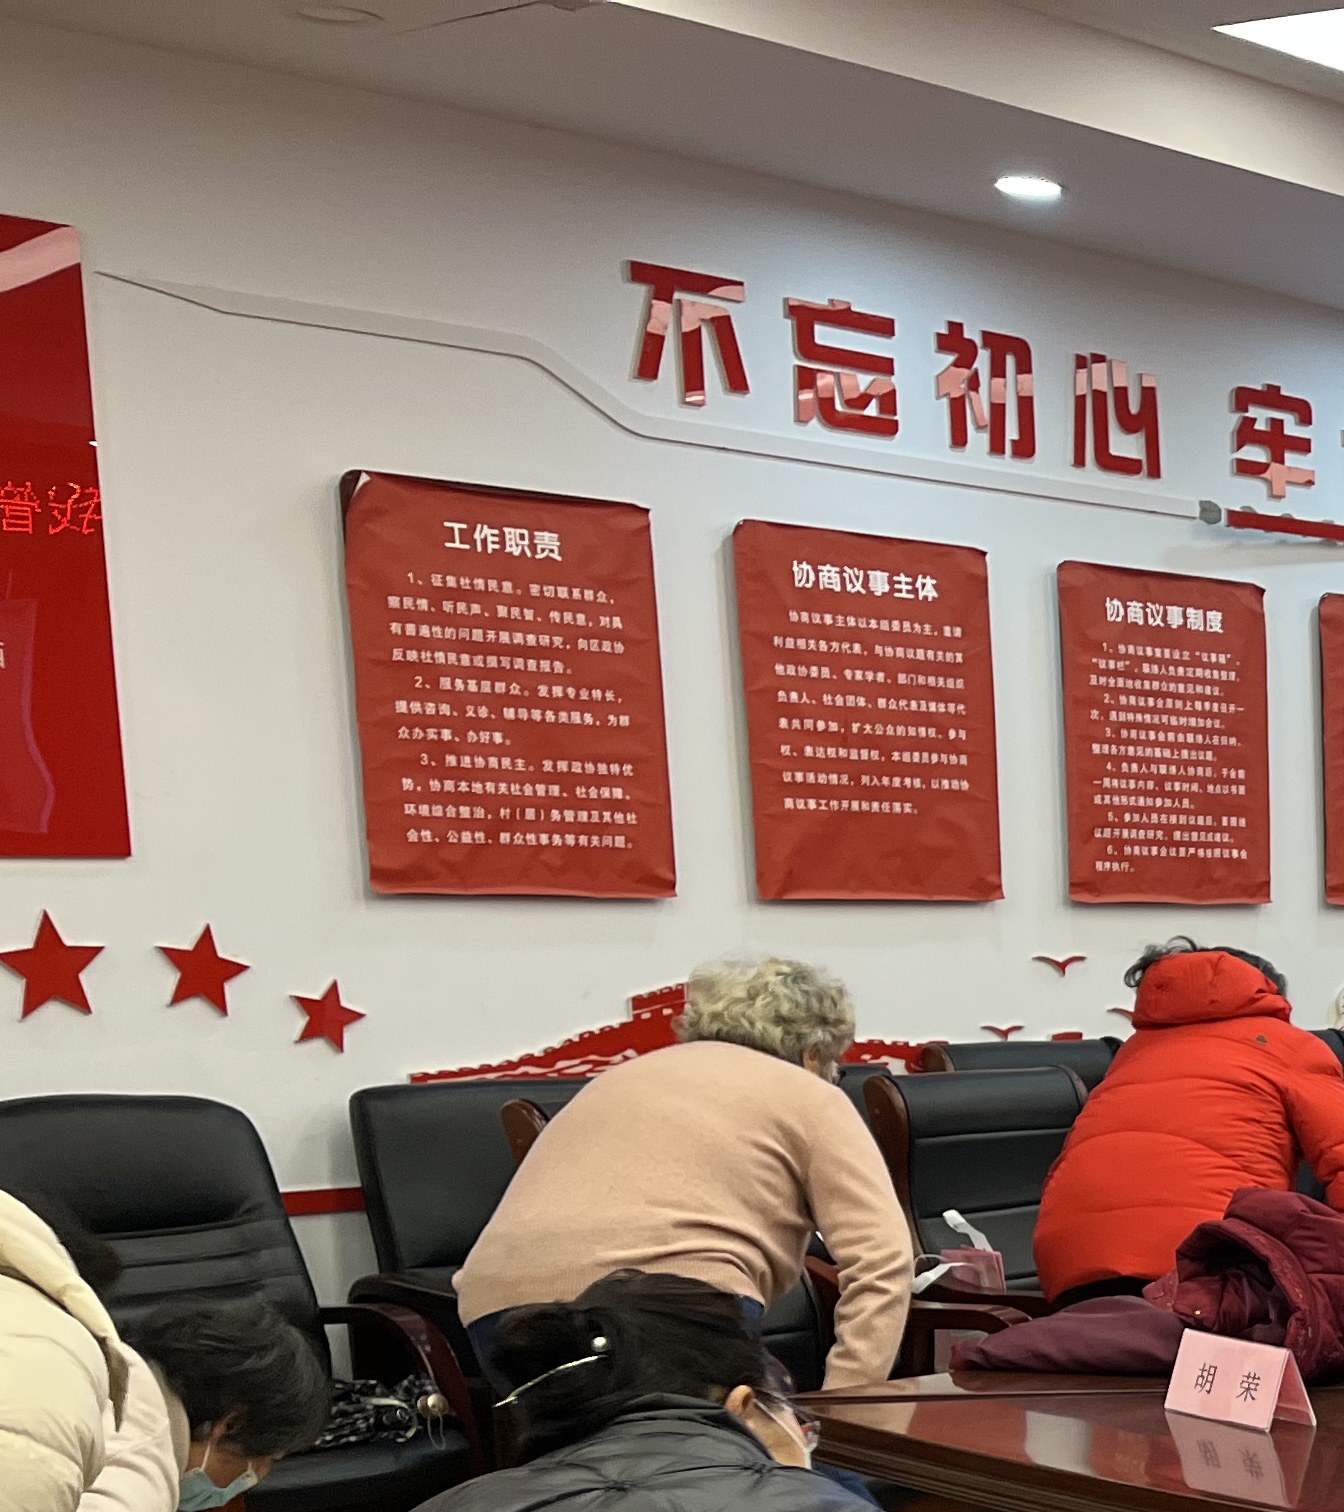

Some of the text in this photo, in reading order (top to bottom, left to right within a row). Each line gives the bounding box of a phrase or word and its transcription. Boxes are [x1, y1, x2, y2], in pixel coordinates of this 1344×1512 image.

[625, 259, 1163, 481] 不忘初心
[443, 521, 562, 561] 工作职责
[792, 560, 938, 601] 协商议事主体
[1105, 597, 1224, 633] 协商议事制度
[1194, 1362, 1261, 1402] 胡荣
